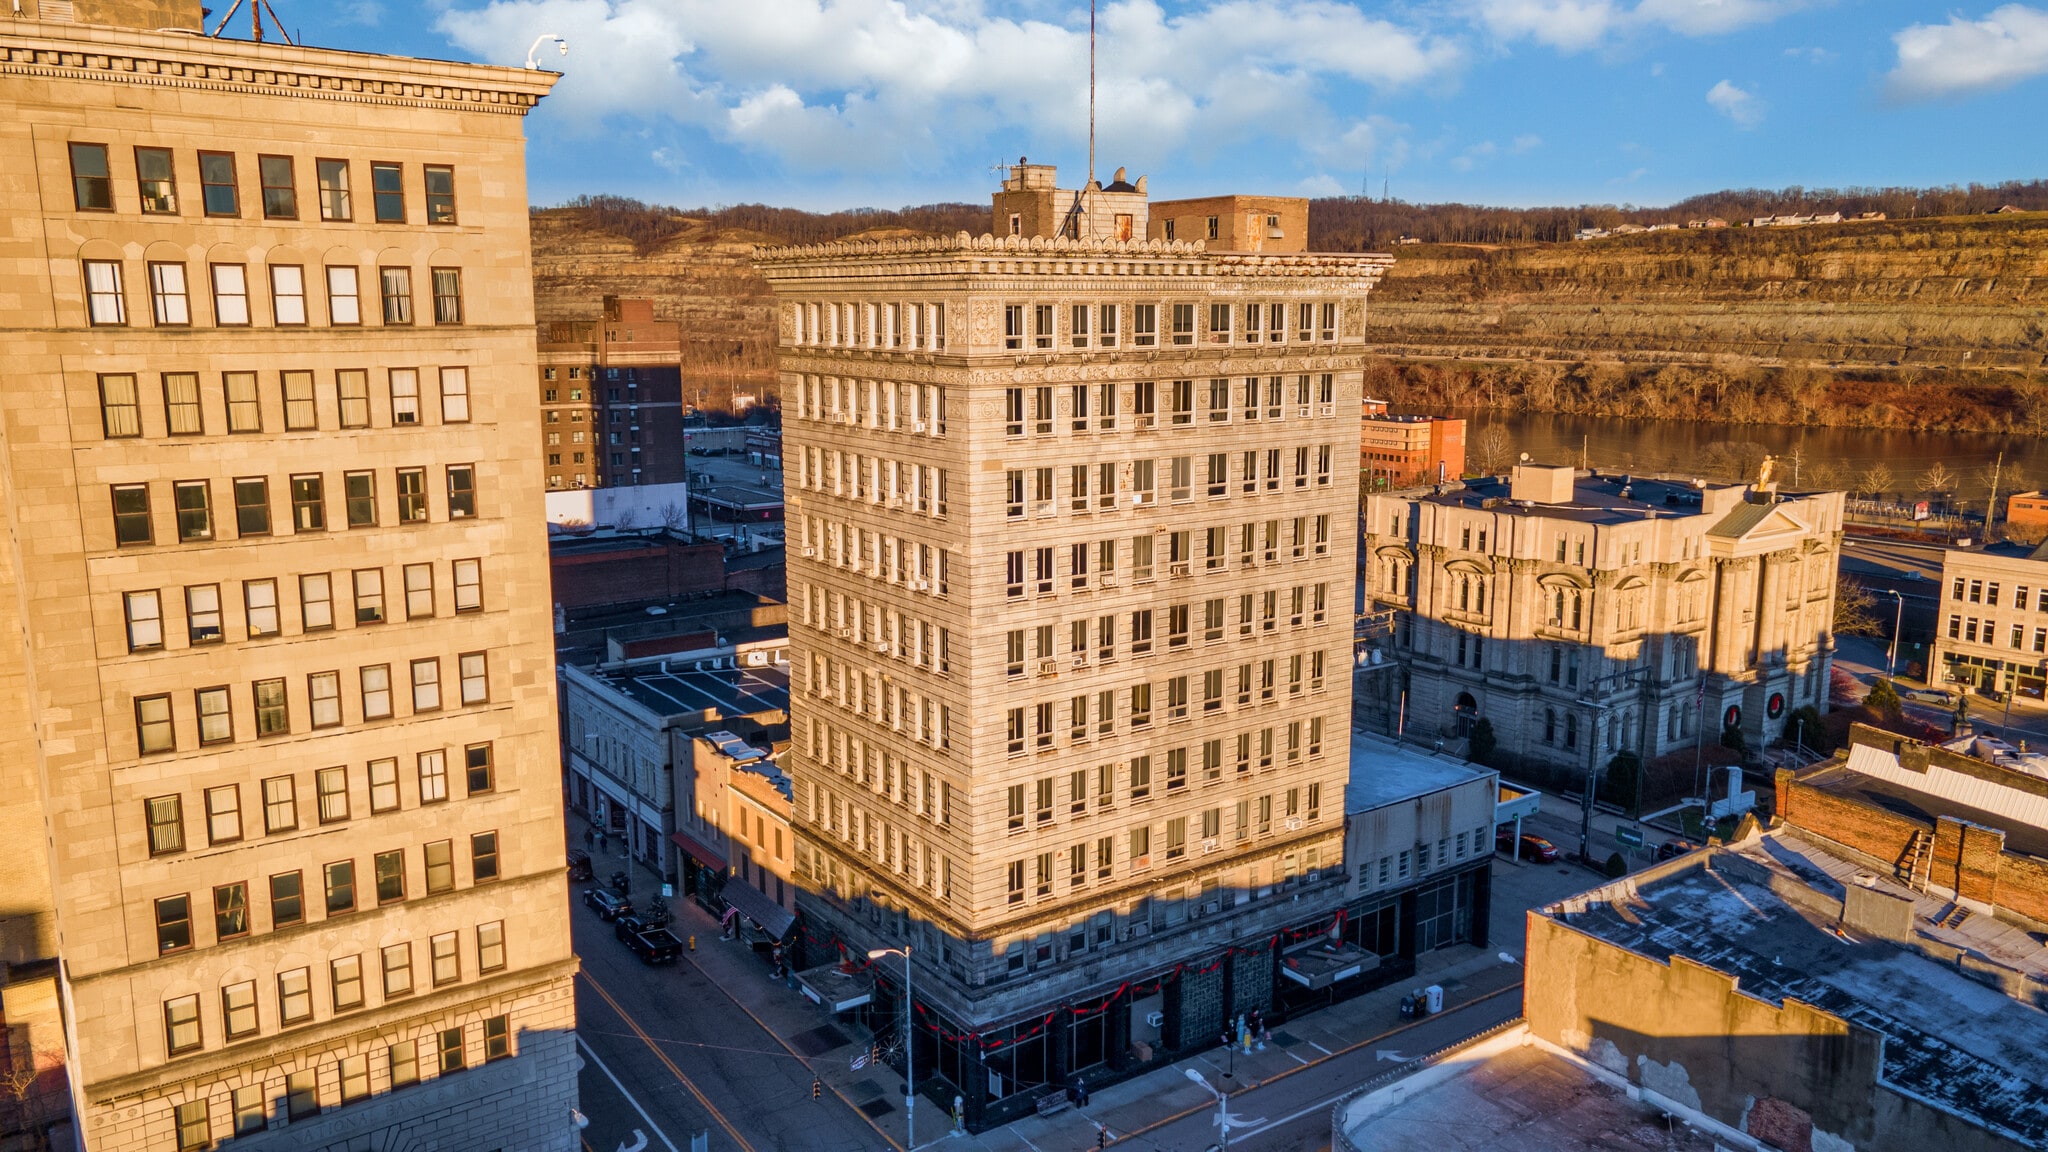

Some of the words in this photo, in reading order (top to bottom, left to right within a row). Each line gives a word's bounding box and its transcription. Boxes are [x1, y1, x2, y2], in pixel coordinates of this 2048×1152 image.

[290, 1110, 374, 1145] NATIONAL
[385, 1093, 429, 1117] BANK
[454, 1075, 494, 1096] TRUST
